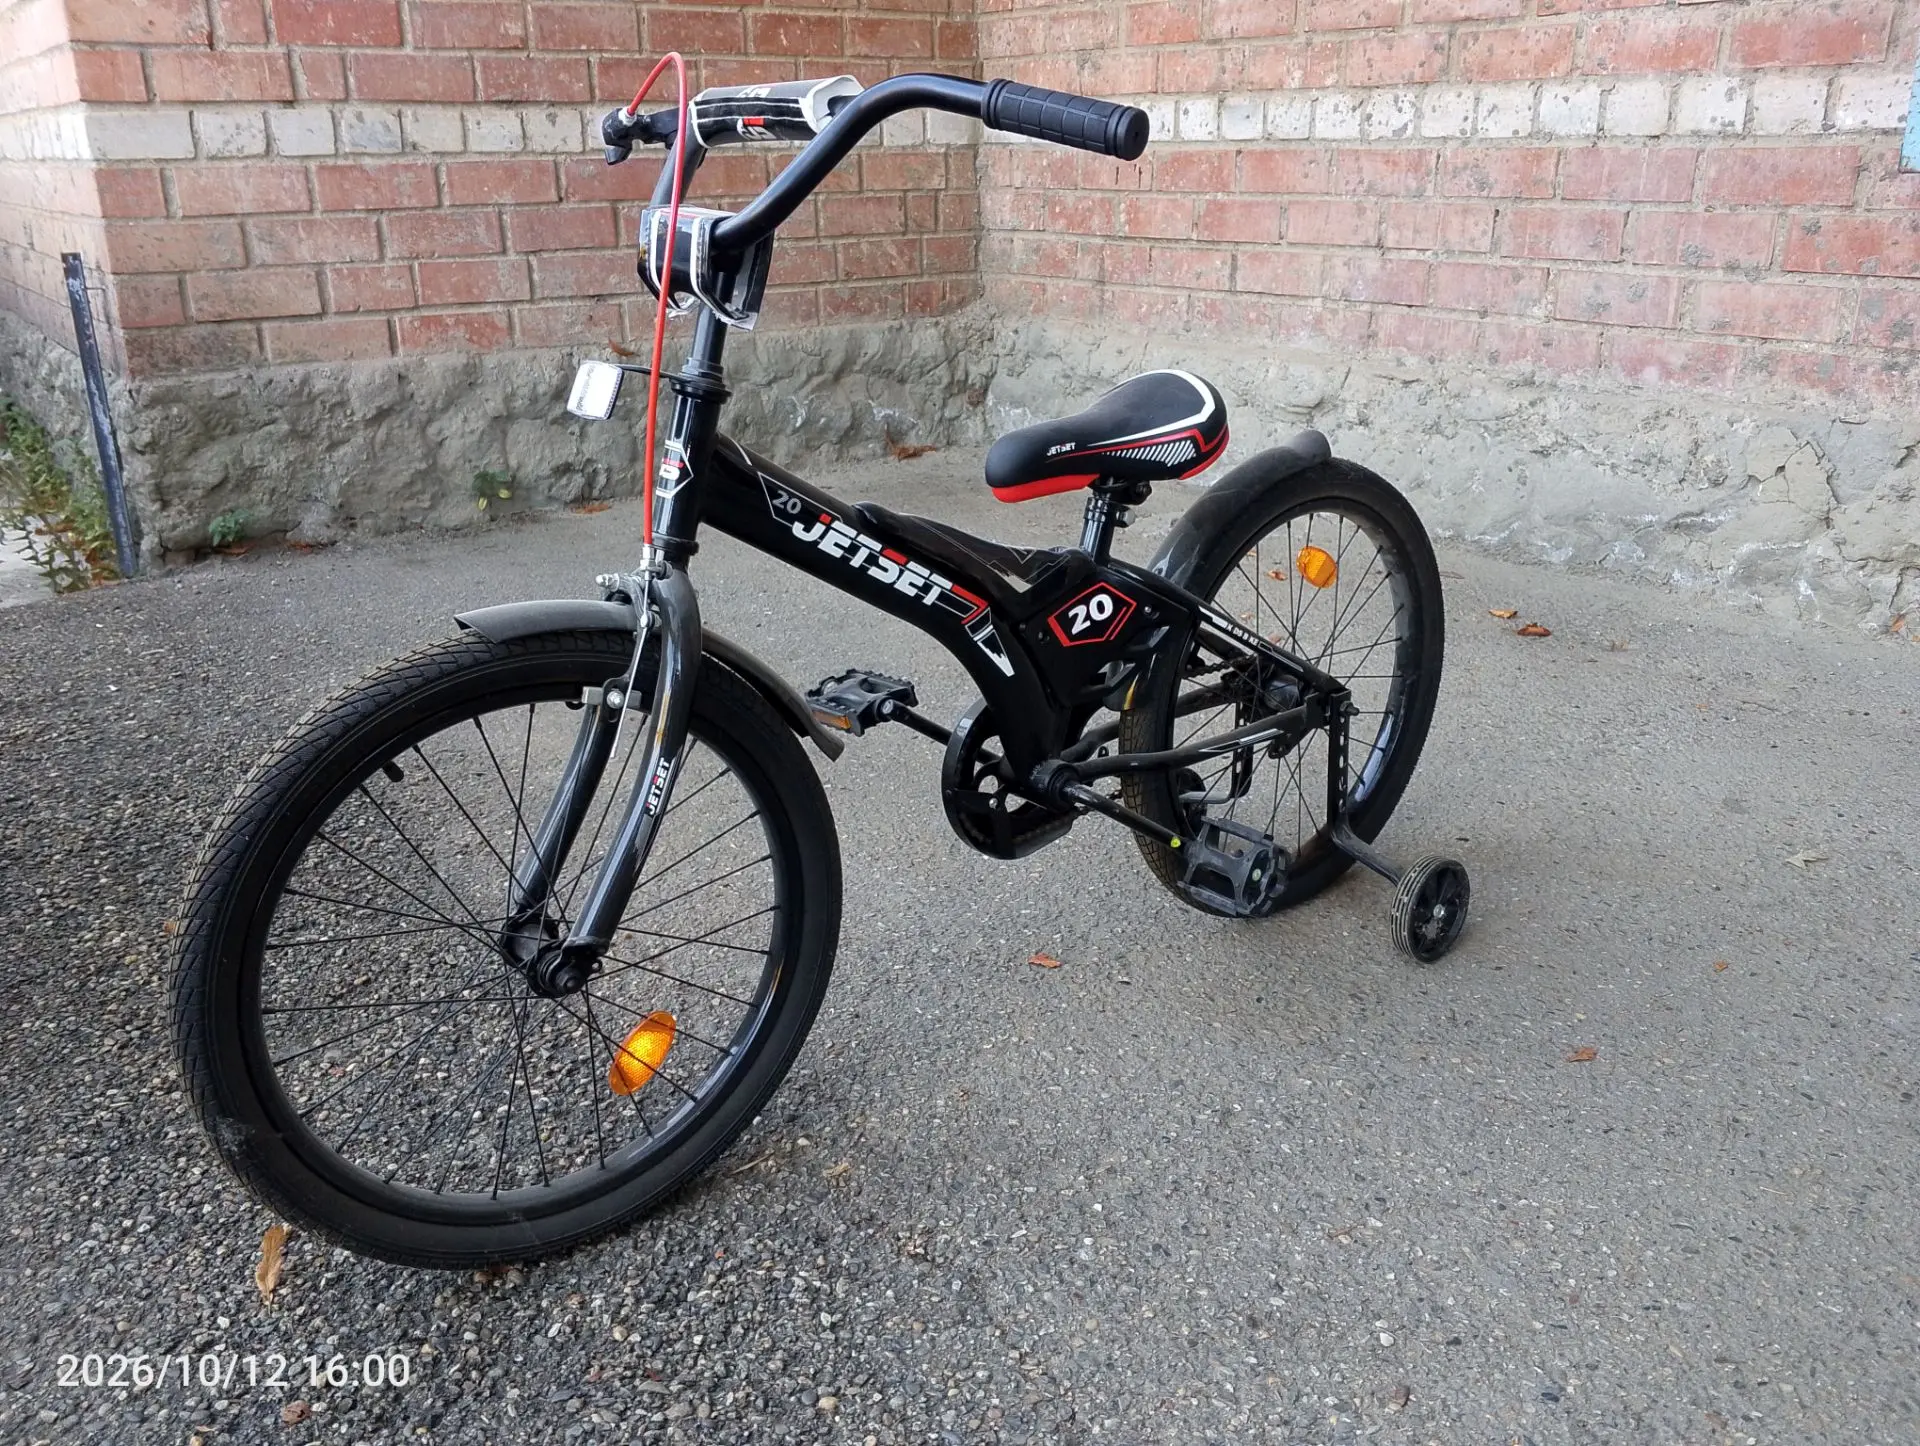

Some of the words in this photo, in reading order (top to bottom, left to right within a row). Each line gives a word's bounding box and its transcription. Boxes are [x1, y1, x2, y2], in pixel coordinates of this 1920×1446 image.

[1046, 440, 1076, 457] JETSET
[771, 490, 802, 515] 20
[791, 513, 954, 606] JETSET
[1068, 593, 1114, 635] 20
[646, 757, 670, 815] JETSET
